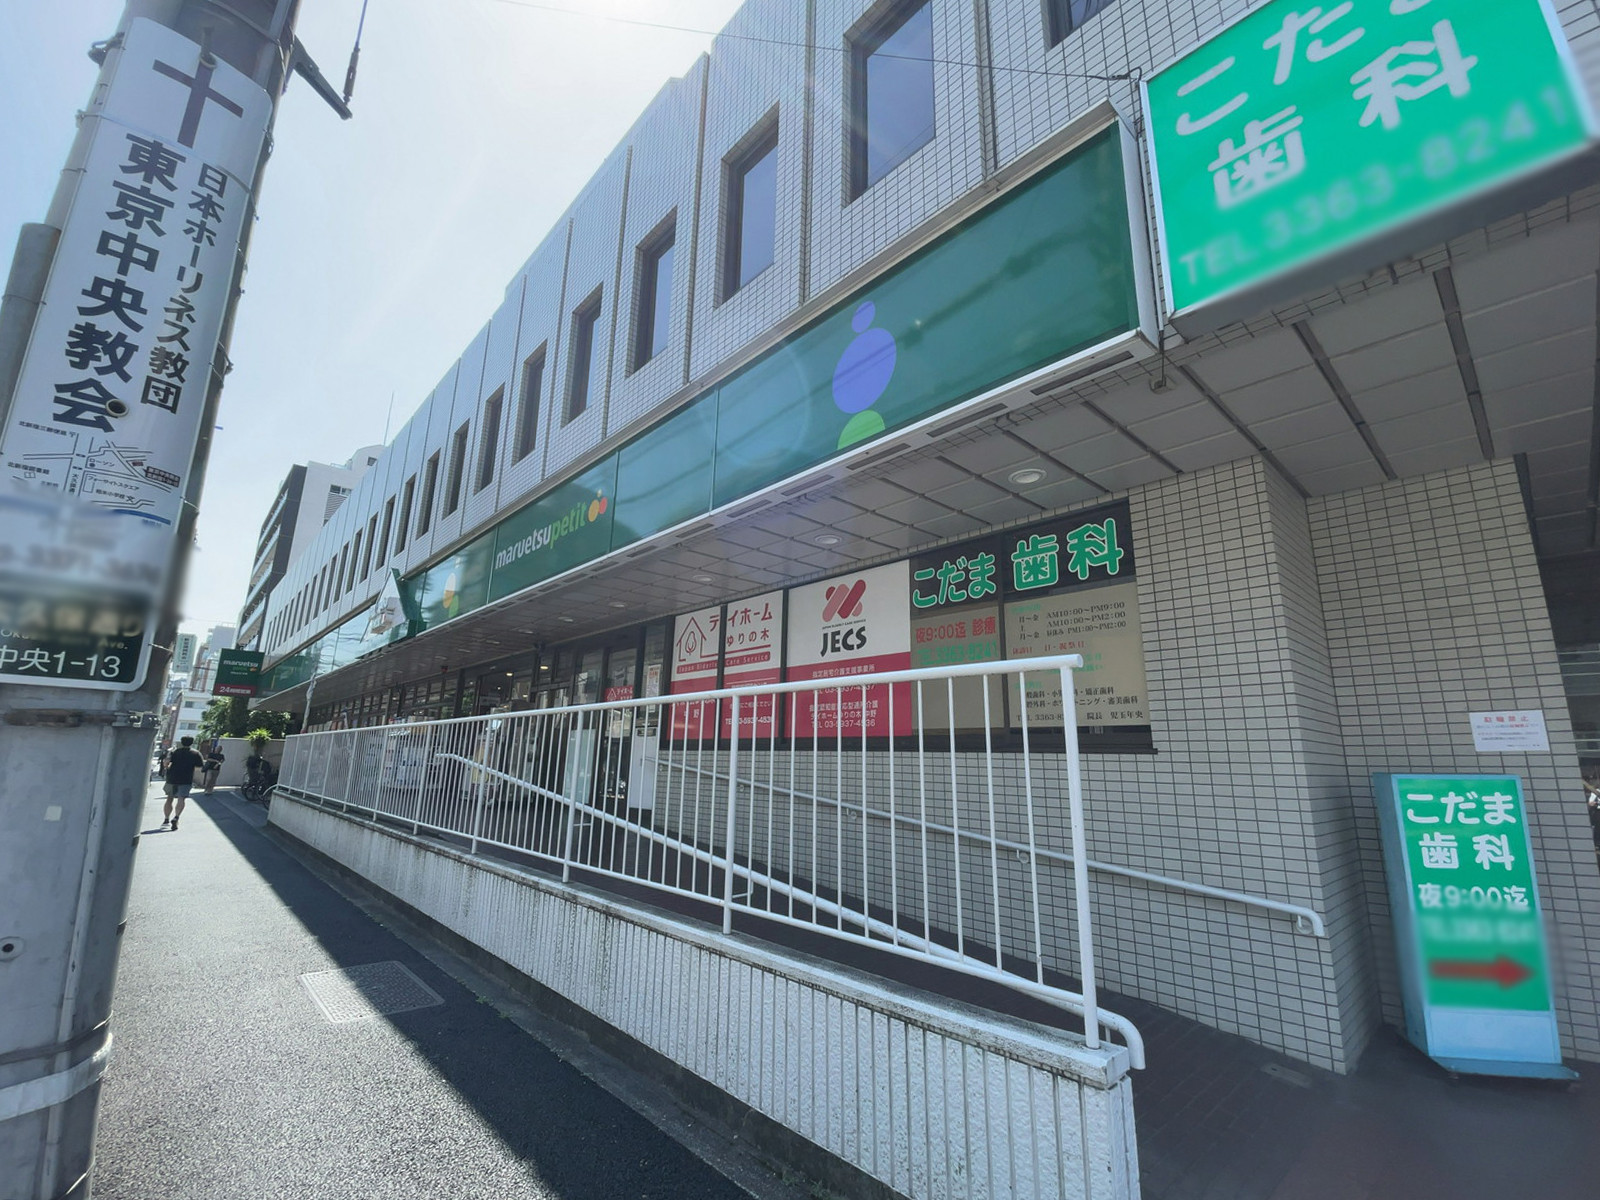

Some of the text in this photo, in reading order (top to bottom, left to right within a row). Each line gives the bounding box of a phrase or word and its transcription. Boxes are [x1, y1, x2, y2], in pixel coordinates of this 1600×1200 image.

[1176, 0, 1434, 137] こだ
[1208, 18, 1479, 212] 歯科
[53, 132, 187, 433] 東京中央教会
[140, 163, 228, 414] 日本ホーリネス教団
[912, 517, 1124, 608] こだま 歯科
[726, 628, 770, 647] ゆりの木
[820, 626, 867, 657] JECS
[972, 616, 996, 637] 診療
[0, 645, 121, 678] 中央1-13
[1406, 791, 1517, 825] こだま
[1418, 832, 1515, 871] 歯科
